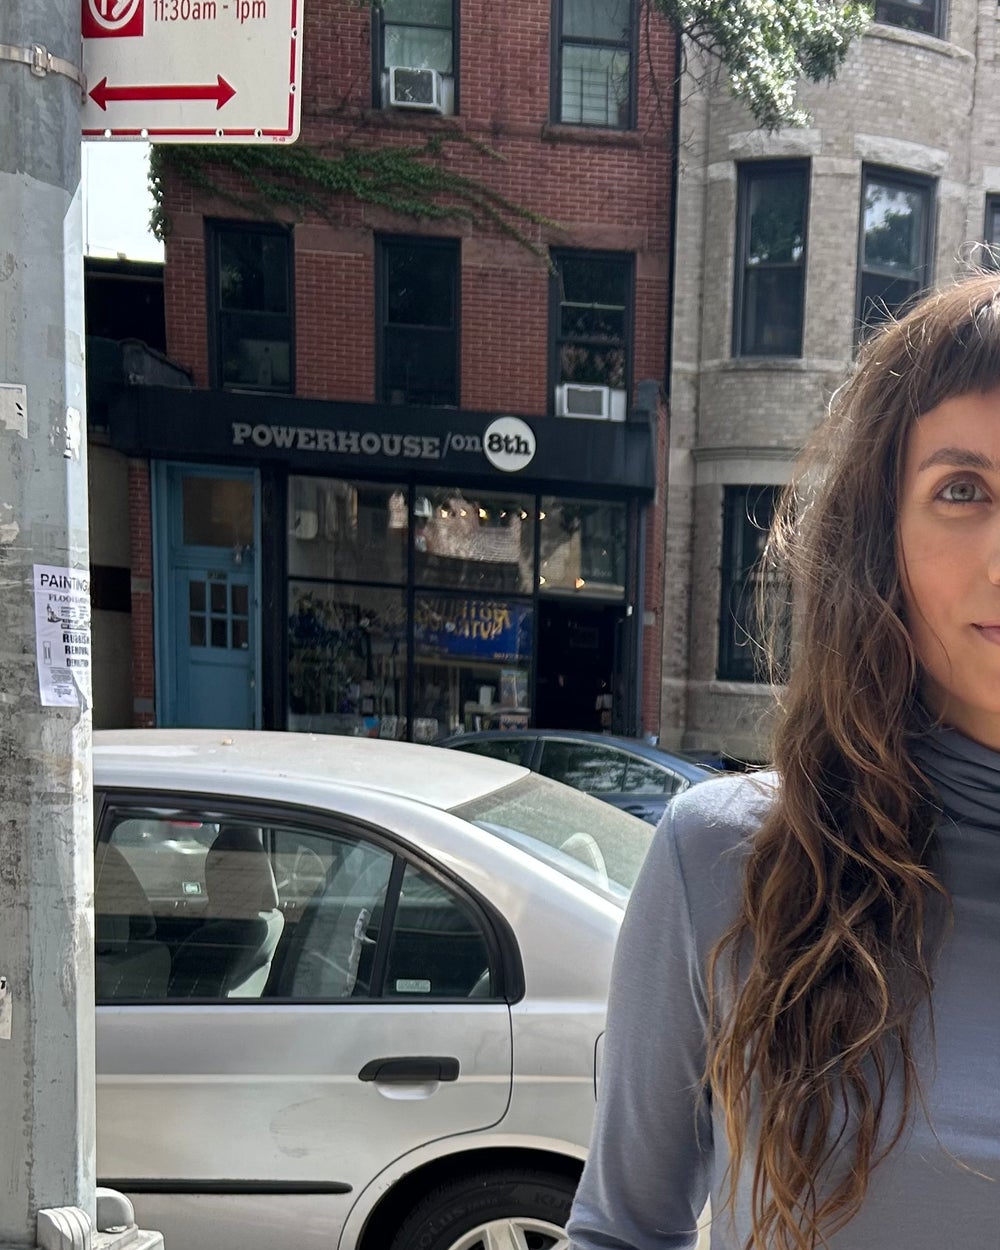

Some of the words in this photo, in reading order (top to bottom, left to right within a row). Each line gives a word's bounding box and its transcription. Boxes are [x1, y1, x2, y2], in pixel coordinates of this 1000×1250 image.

[152, 0, 217, 21] 11:30am
[235, 0, 266, 24] 1pm
[486, 432, 531, 456] 8th
[40, 573, 88, 592] PAINTING
